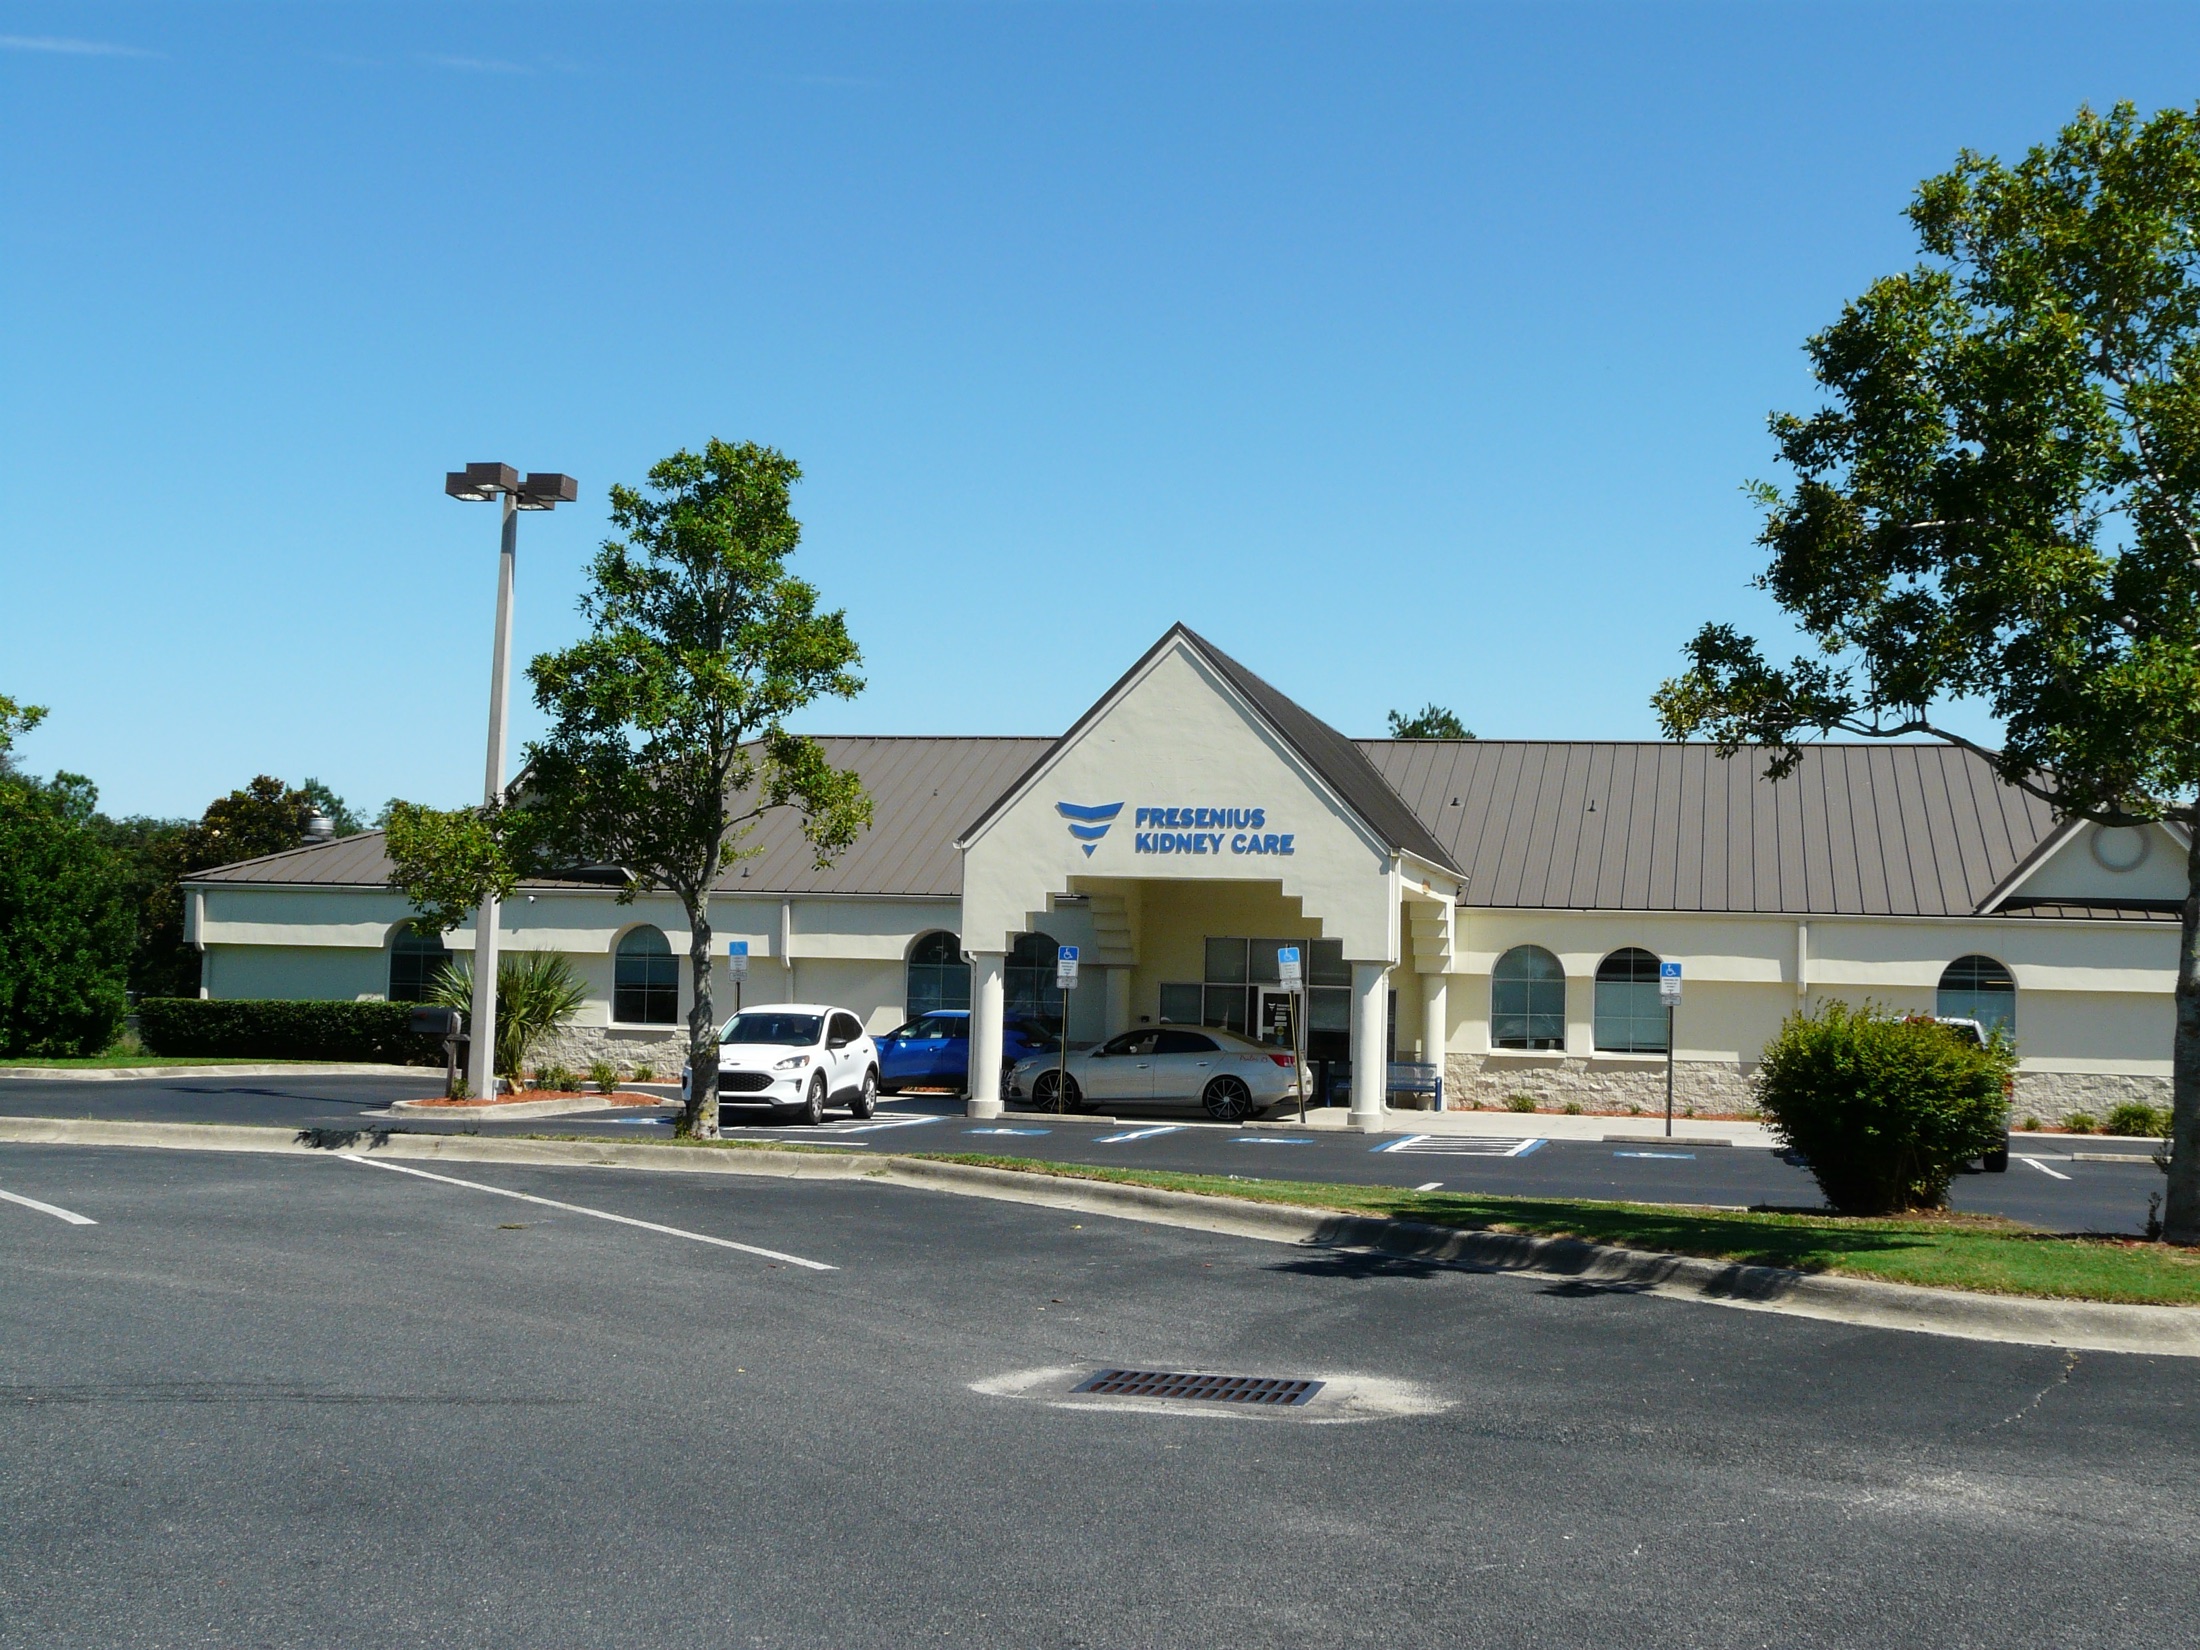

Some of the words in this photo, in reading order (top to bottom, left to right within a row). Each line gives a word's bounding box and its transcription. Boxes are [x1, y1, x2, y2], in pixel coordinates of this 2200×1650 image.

[1135, 807, 1266, 830] FRESENIUS
[1135, 832, 1226, 855] KIDNEY
[1231, 834, 1295, 856] CARE
